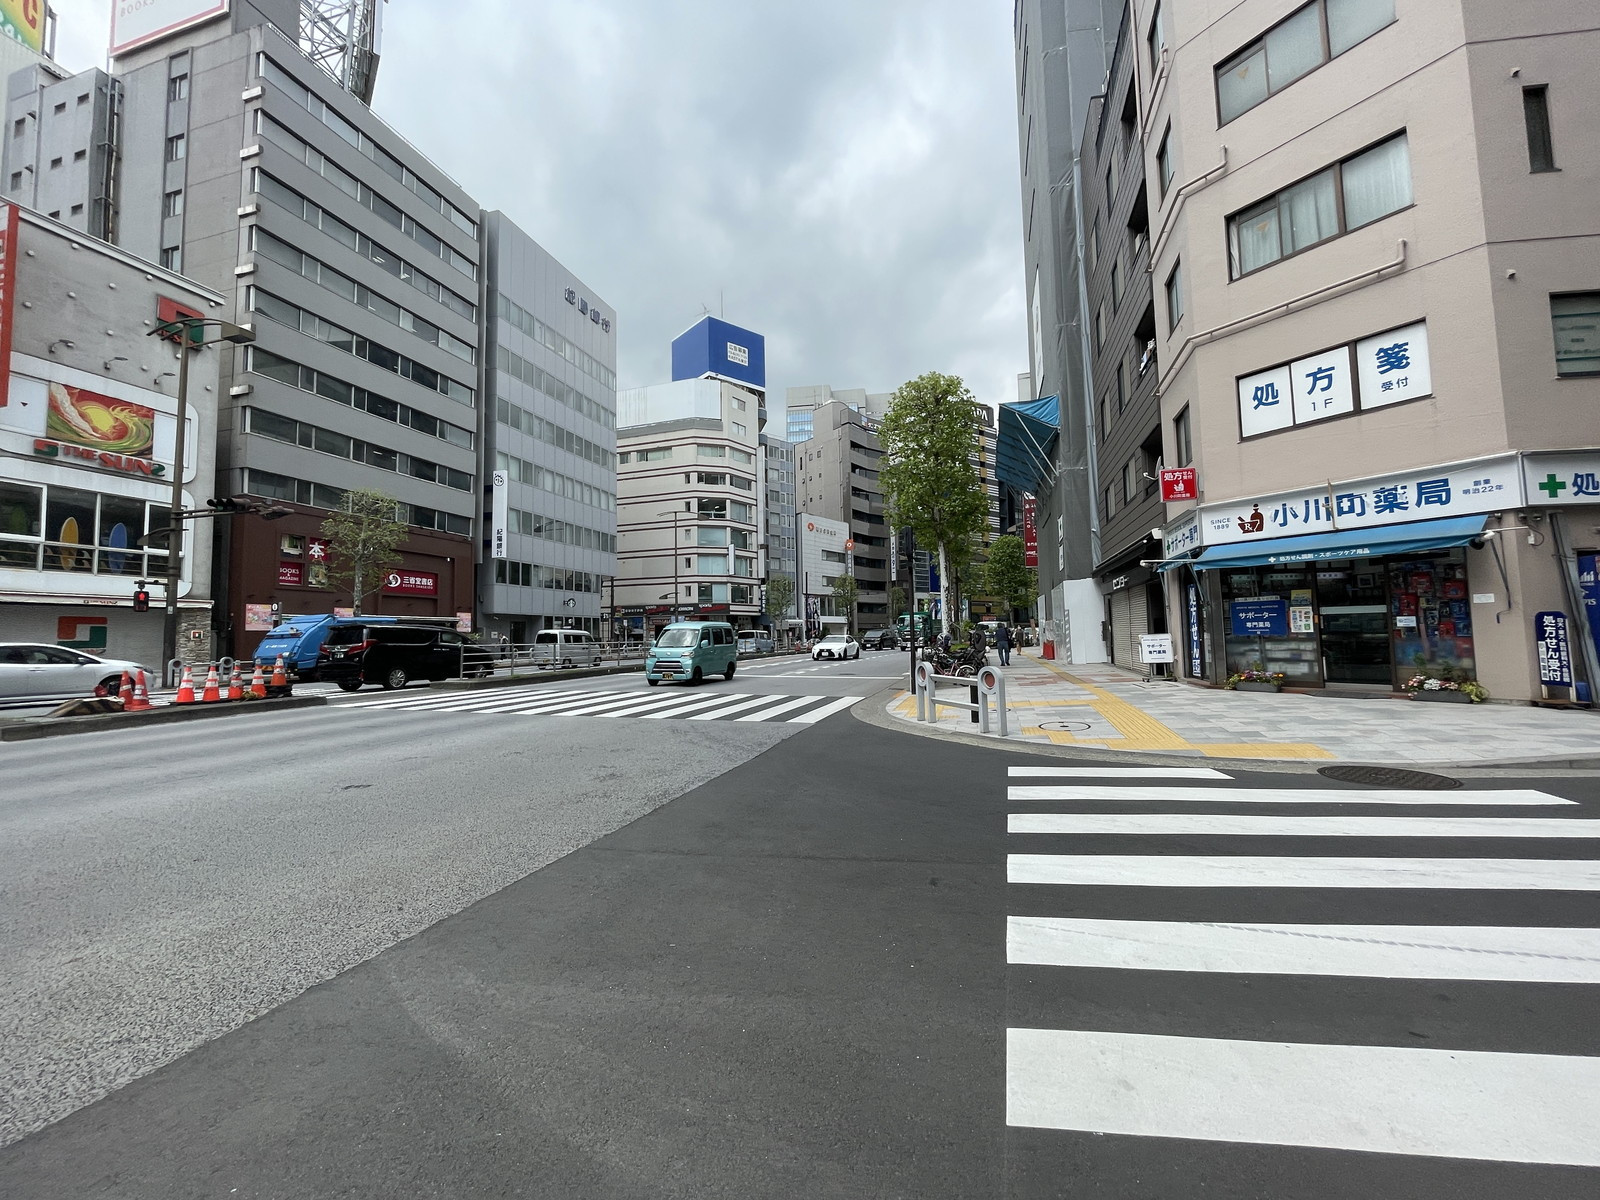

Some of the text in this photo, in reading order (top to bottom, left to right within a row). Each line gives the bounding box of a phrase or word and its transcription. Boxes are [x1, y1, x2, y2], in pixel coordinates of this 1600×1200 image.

[1381, 376, 1409, 392] 受付
[61, 444, 98, 460] THE
[1164, 471, 1182, 481] 処方
[1462, 484, 1504, 495] 明治22年
[1273, 477, 1451, 527] 小川町薬局
[1210, 517, 1231, 525] SINCE
[309, 542, 325, 559] 本
[403, 576, 433, 586] 三省堂書店
[1238, 611, 1278, 620] サポーター
[1246, 621, 1271, 629] 専門薬局
[1542, 615, 1562, 682] 処方せん受付
